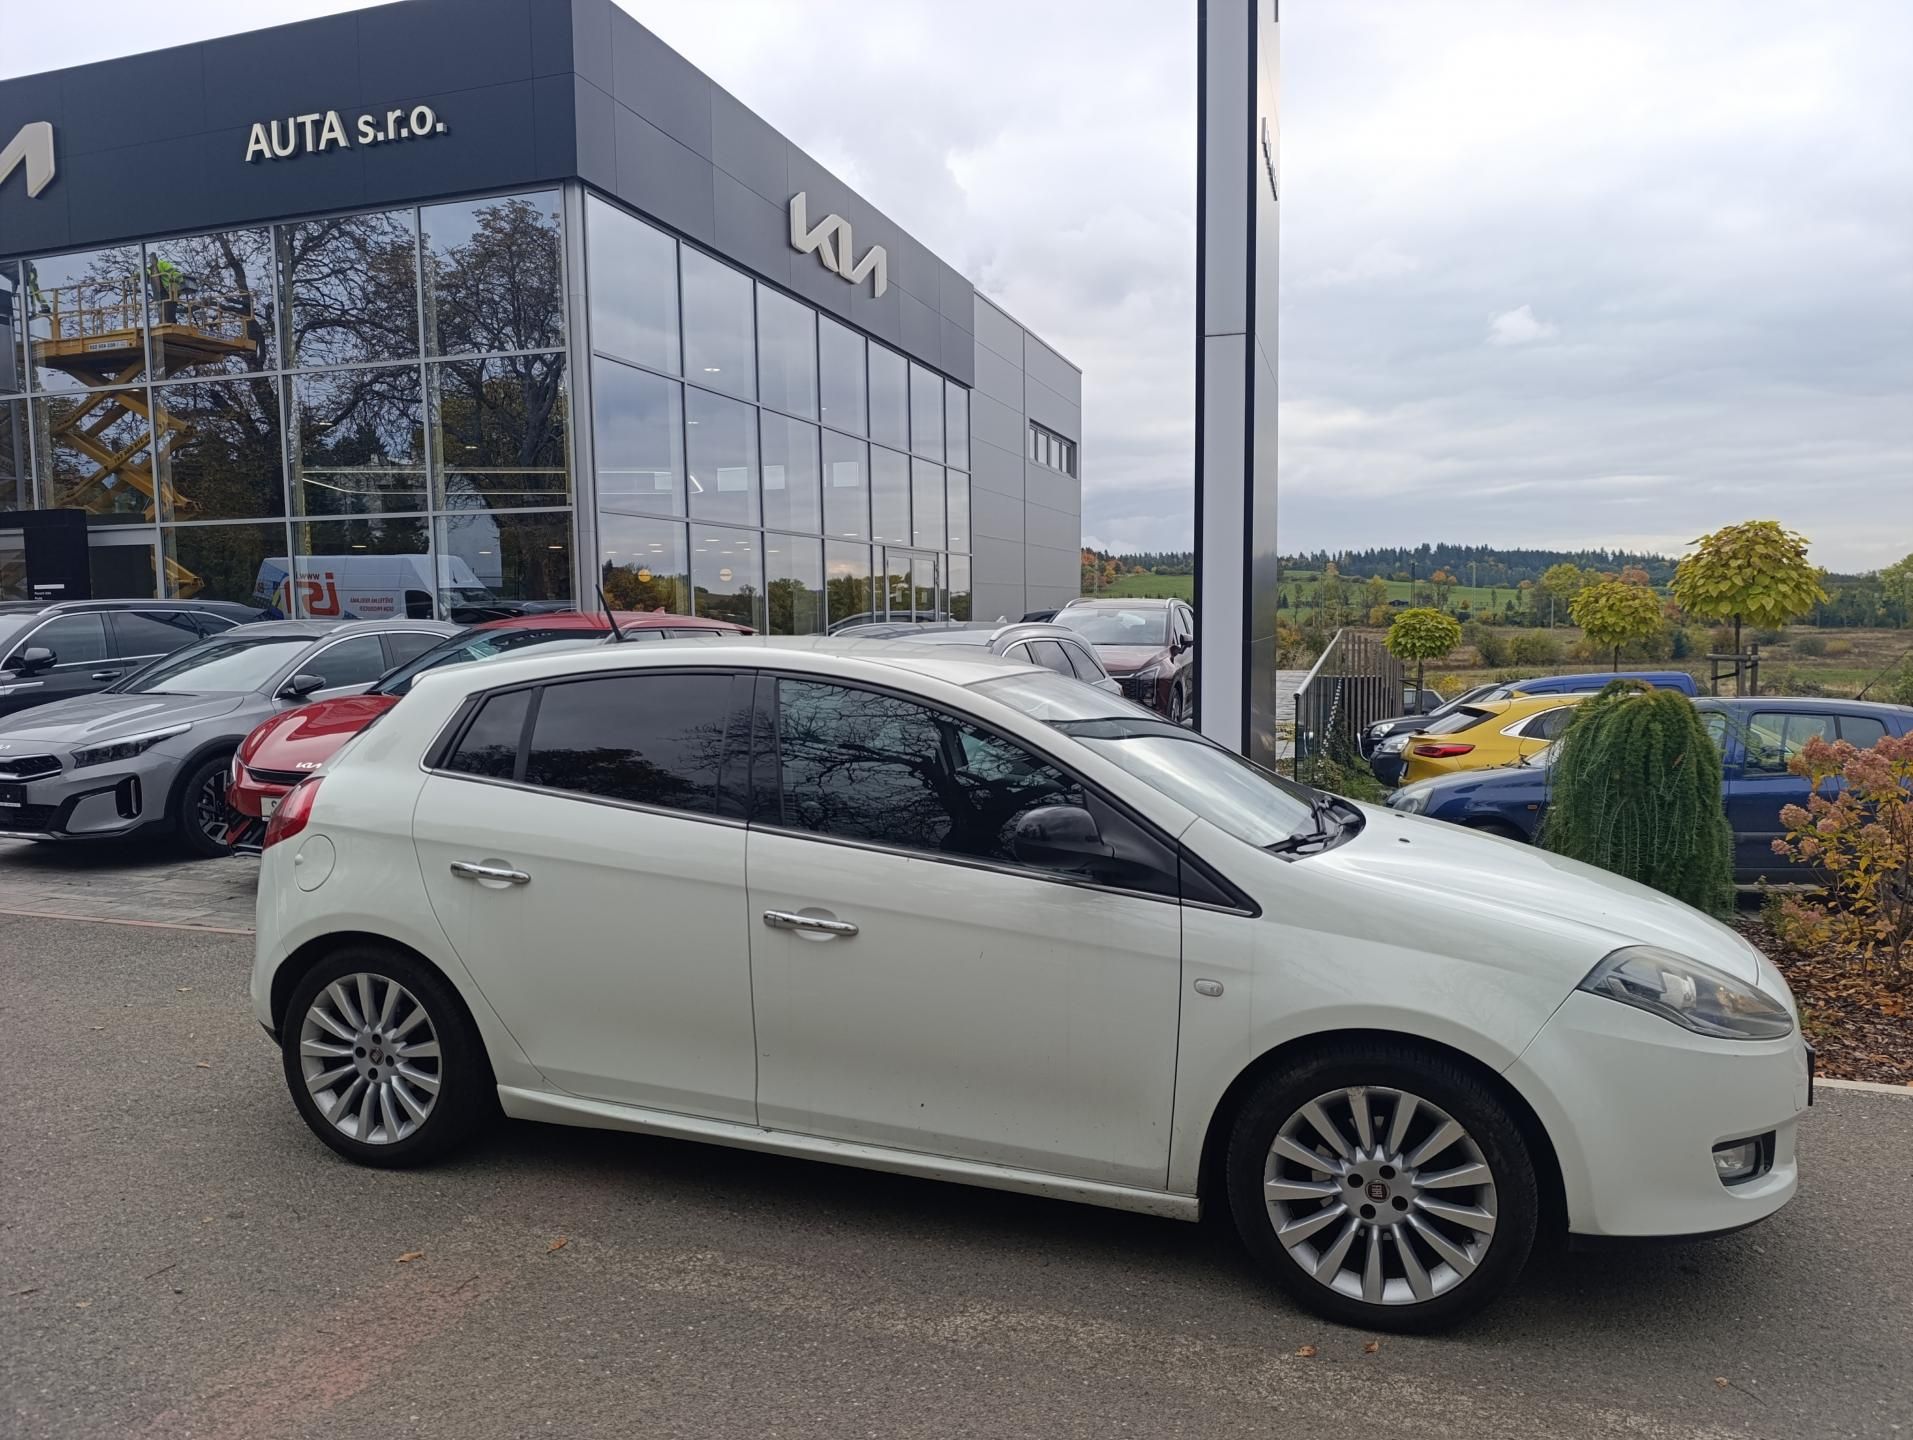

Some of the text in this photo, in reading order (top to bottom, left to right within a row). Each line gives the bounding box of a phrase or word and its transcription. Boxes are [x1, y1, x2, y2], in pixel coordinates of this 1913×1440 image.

[245, 105, 446, 162] AUTA s.r.o.
[790, 191, 887, 298] KIA
